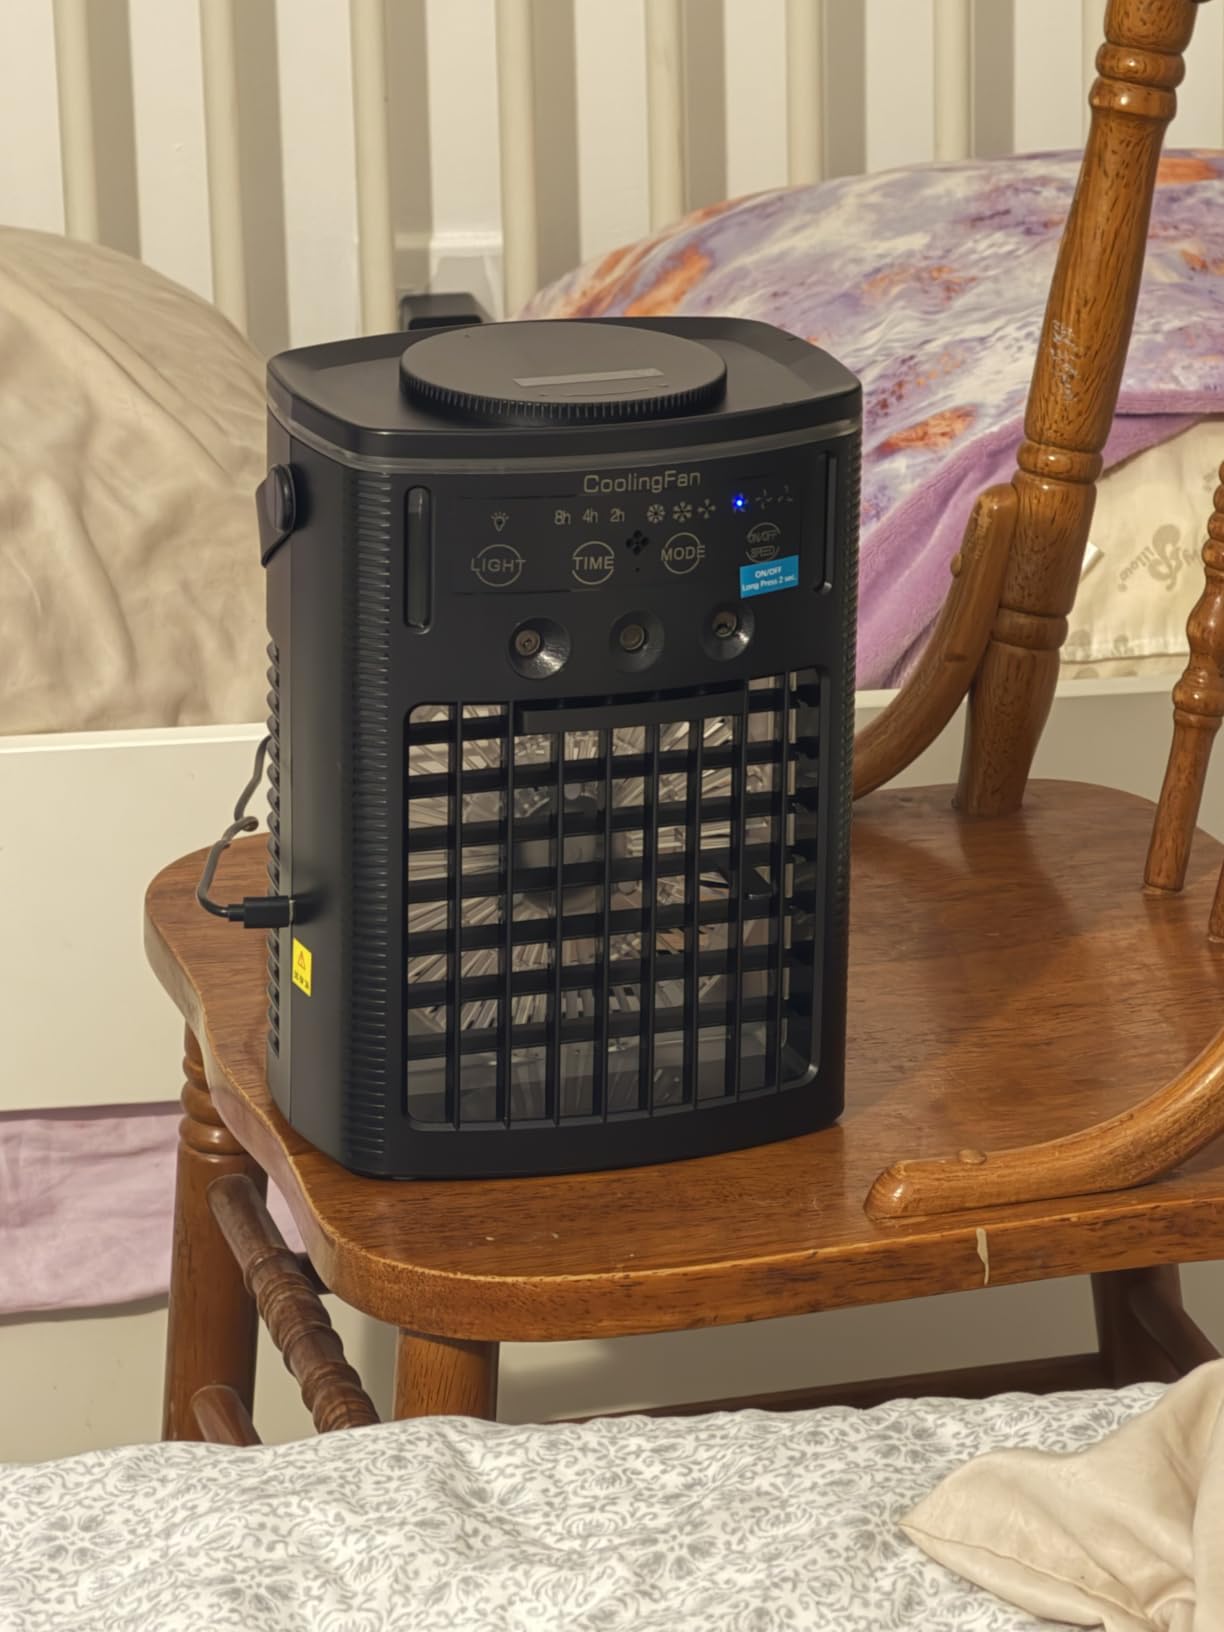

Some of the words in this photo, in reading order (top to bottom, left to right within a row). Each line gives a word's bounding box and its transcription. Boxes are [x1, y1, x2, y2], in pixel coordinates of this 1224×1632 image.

[583, 470, 701, 493] CoolingFan
[554, 510, 571, 525] 8h
[582, 508, 598, 523] 4h
[610, 508, 625, 522] 2h
[661, 545, 705, 561] MODE
[471, 558, 526, 573] LIGHT
[573, 556, 614, 571] TIME
[754, 566, 782, 578] ON/OFF
[742, 582, 760, 592] Long
[760, 578, 777, 588] Press
[779, 575, 784, 584] 2
